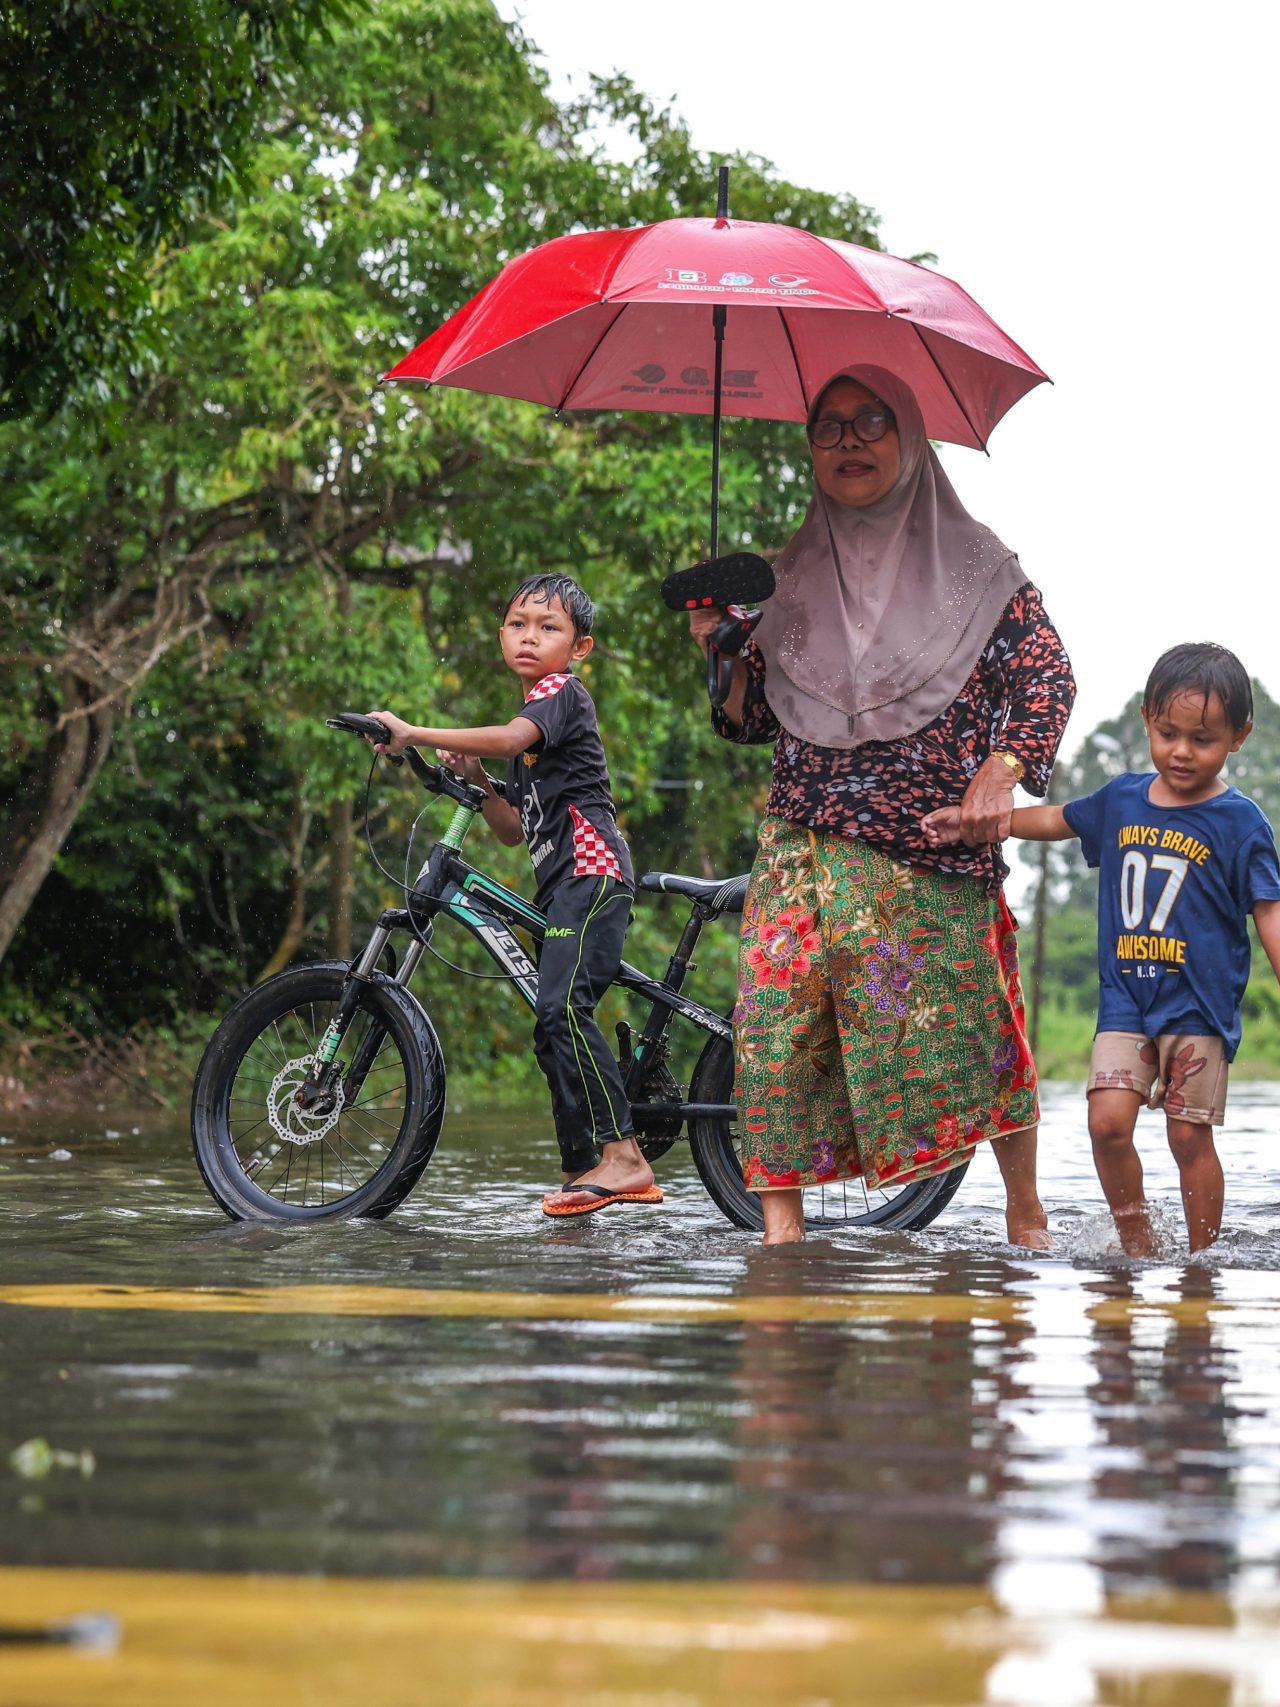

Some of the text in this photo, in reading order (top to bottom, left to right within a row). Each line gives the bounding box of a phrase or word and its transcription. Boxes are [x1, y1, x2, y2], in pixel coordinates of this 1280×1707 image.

[1160, 829, 1211, 866] BRAVE
[1120, 850, 1190, 932] 07
[678, 1006, 730, 1036] JETSPORT
